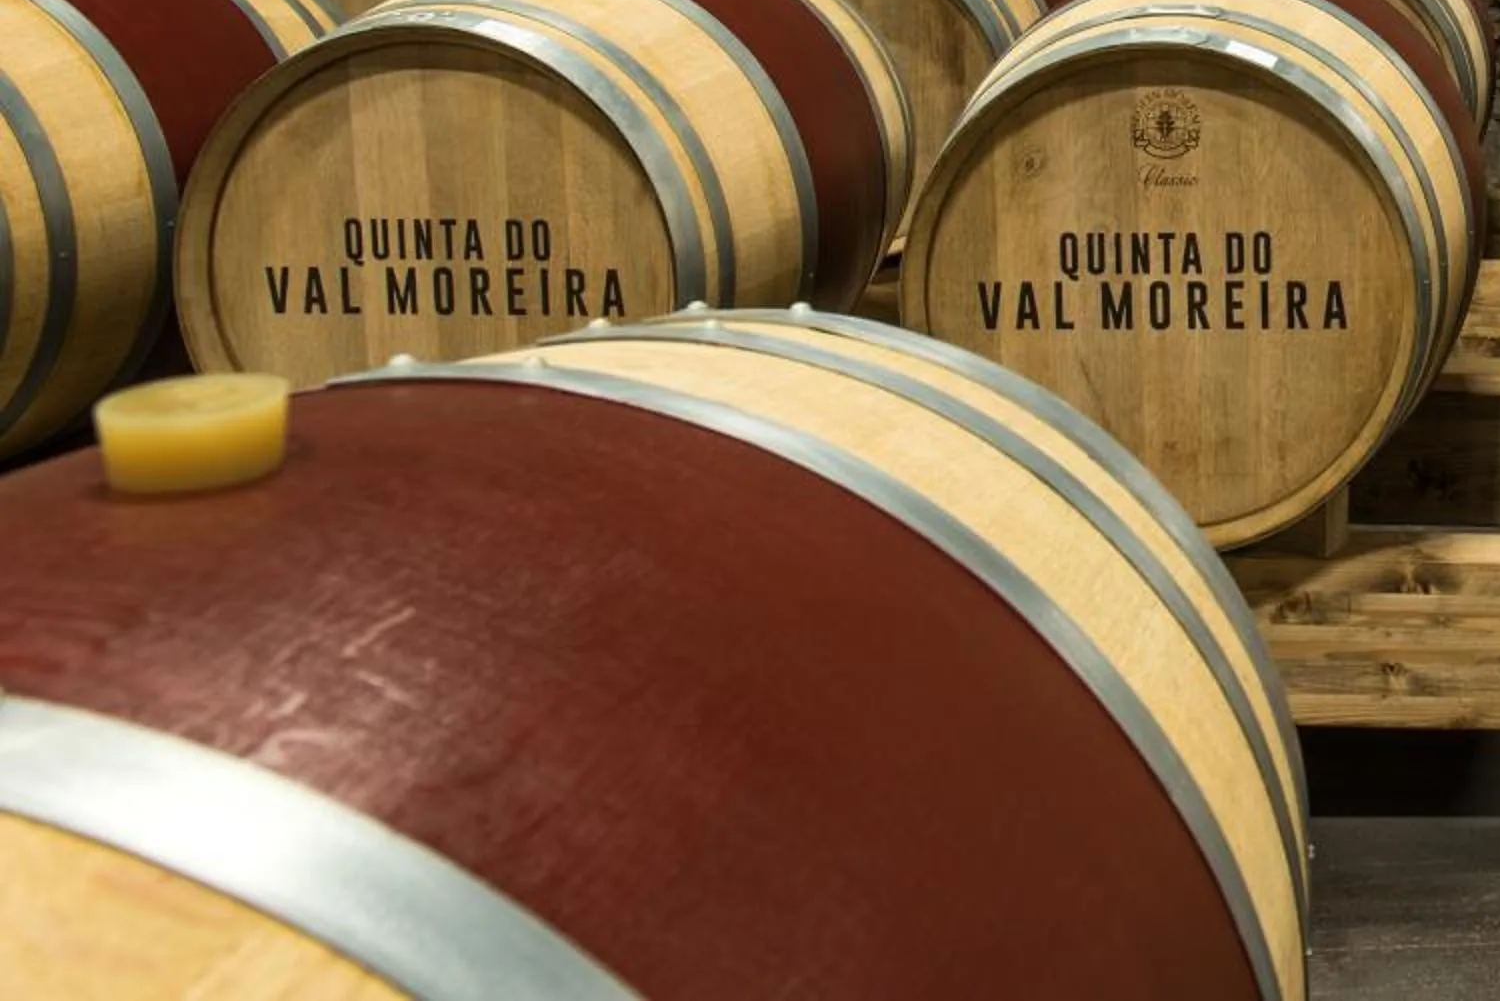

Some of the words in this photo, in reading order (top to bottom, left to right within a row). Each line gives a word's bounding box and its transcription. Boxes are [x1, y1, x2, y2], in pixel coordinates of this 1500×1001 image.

[344, 218, 484, 267] QUINTA
[505, 219, 551, 261] DO
[1059, 232, 1203, 281] QUINTA
[1225, 231, 1272, 275] DO
[265, 266, 361, 315] VAL
[386, 266, 625, 317] MOREIRA
[977, 281, 1075, 330] VAL
[1101, 280, 1347, 330] MOREIRA
